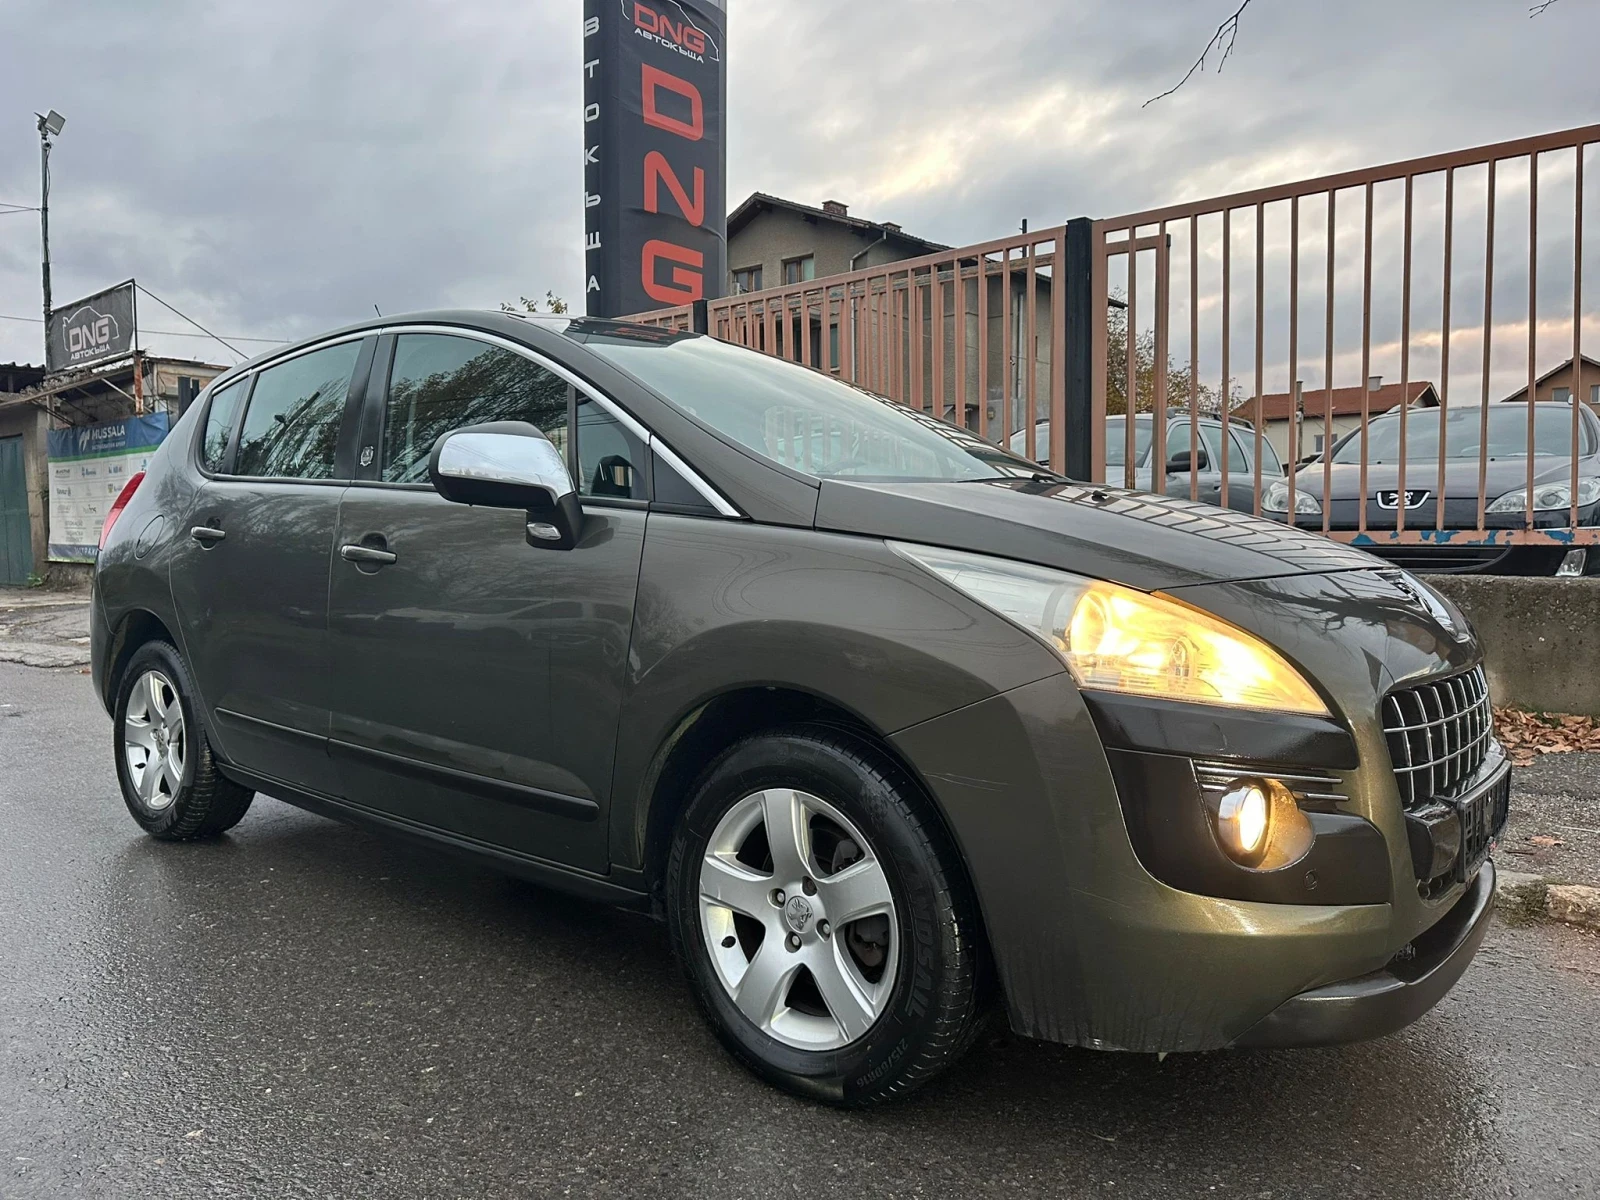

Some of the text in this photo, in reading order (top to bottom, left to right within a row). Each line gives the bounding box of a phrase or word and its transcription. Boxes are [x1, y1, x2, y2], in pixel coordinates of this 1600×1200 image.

[634, 2, 706, 55] DNG
[641, 62, 704, 306] DNG
[69, 317, 110, 352] DNG
[91, 425, 126, 440] MUSSALA
